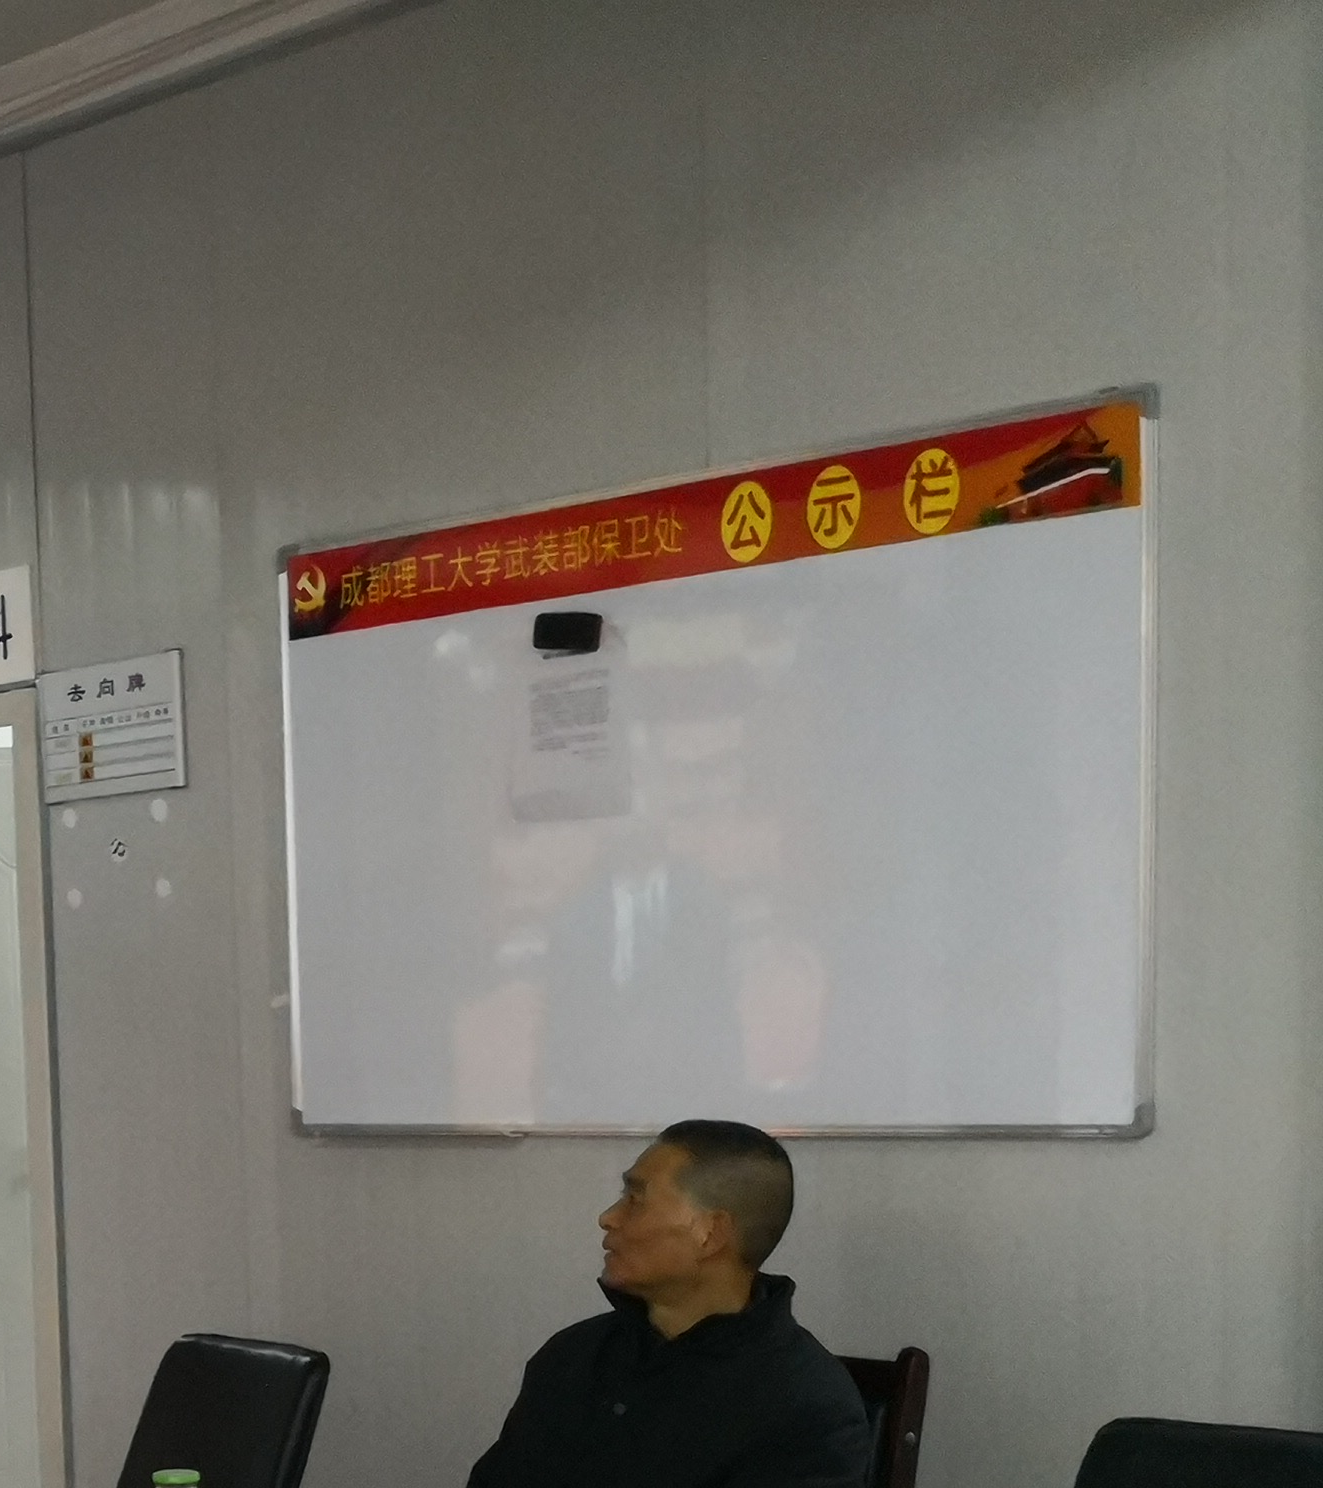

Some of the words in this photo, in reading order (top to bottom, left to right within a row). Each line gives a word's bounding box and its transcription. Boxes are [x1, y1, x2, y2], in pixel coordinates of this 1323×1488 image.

[339, 508, 684, 609] 成都理工大学武装部保卫处
[727, 457, 955, 549] 公示栏
[67, 673, 146, 702] 去向牌
